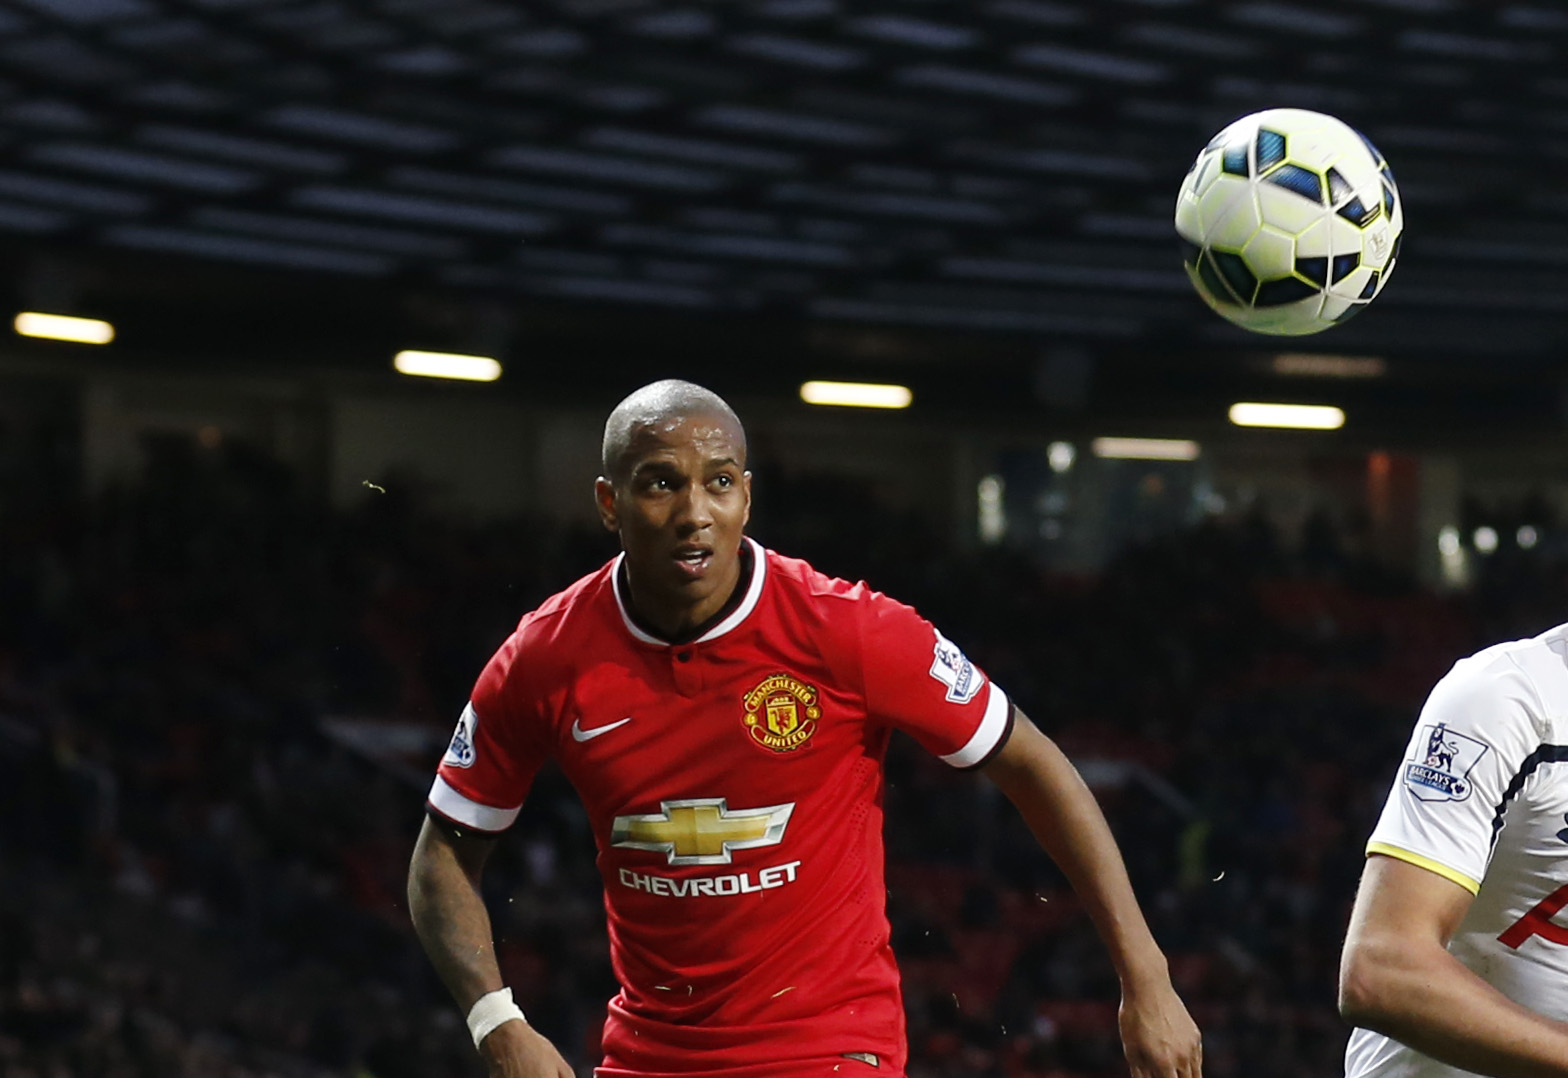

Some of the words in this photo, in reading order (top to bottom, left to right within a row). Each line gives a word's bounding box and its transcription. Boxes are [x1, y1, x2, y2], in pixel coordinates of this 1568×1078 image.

[750, 680, 812, 707] MANCHESTER
[763, 731, 807, 747] UNITED
[618, 860, 802, 898] CHEVROLET
